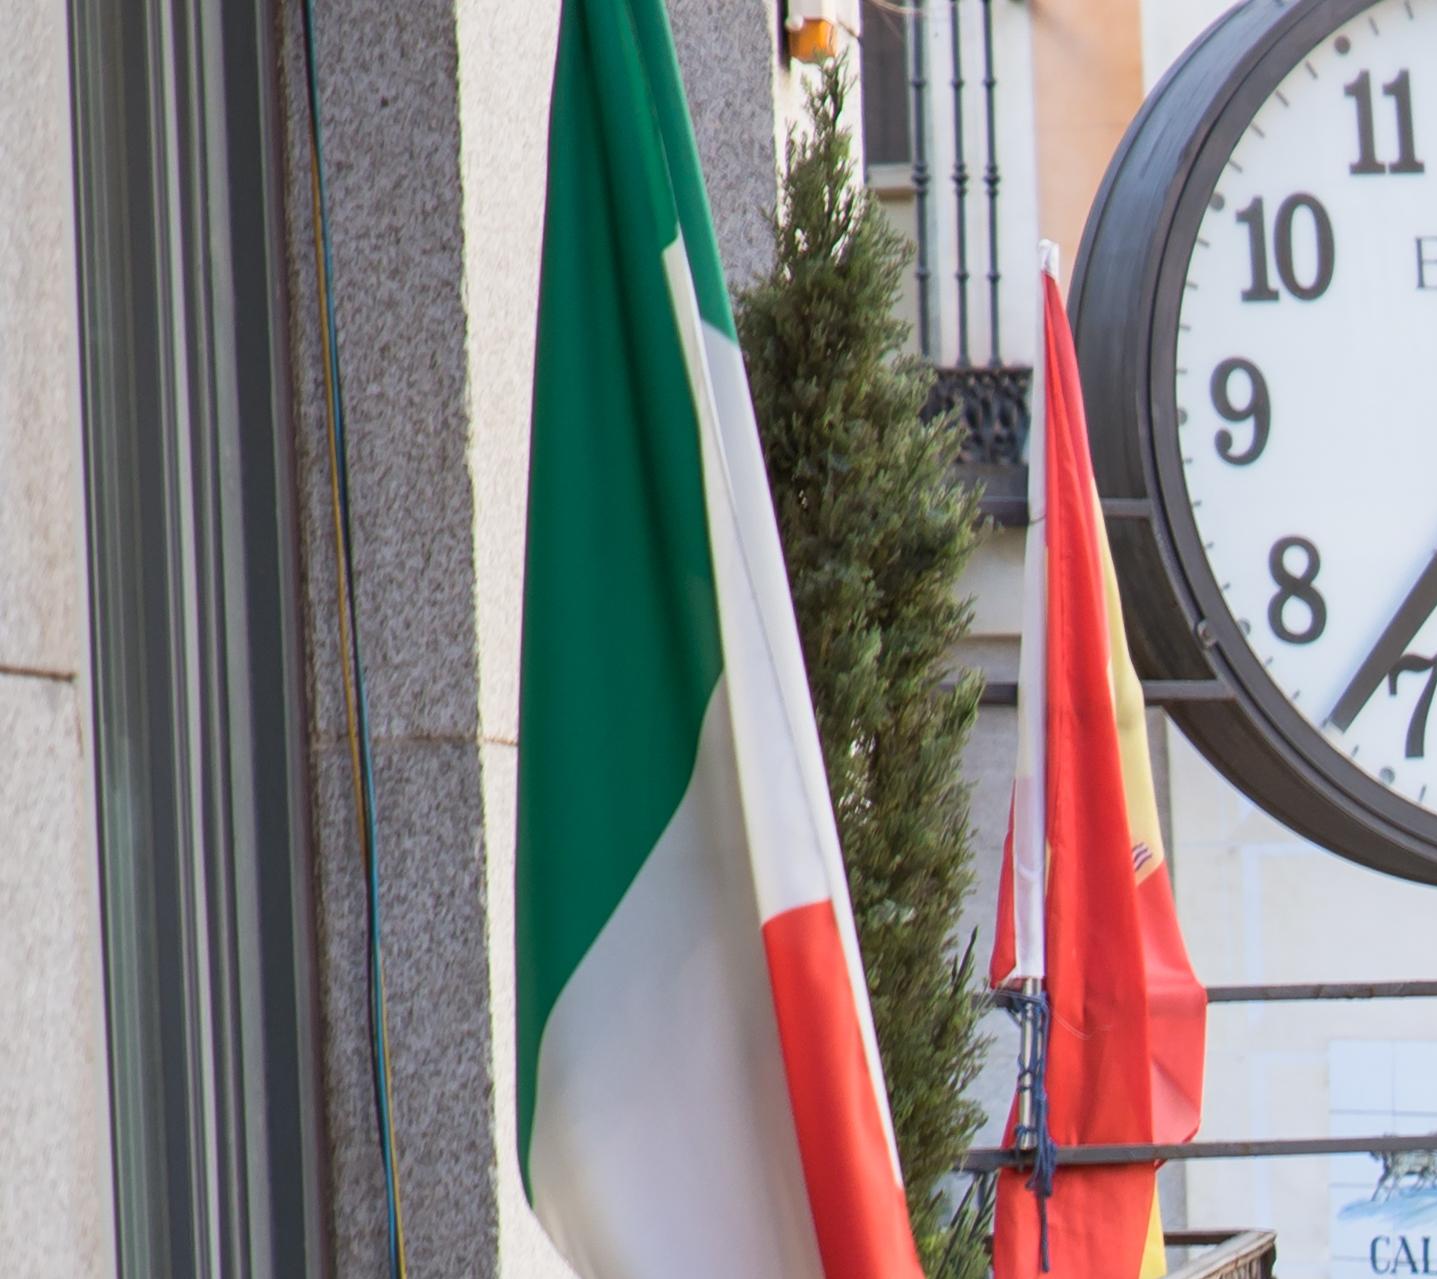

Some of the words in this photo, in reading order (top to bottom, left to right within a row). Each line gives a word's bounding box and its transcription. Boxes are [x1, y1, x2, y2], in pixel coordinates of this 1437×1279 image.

[1344, 69, 1426, 176] 11
[1236, 192, 1336, 302] 10
[1209, 357, 1271, 466] 9
[1266, 535, 1328, 646] 8
